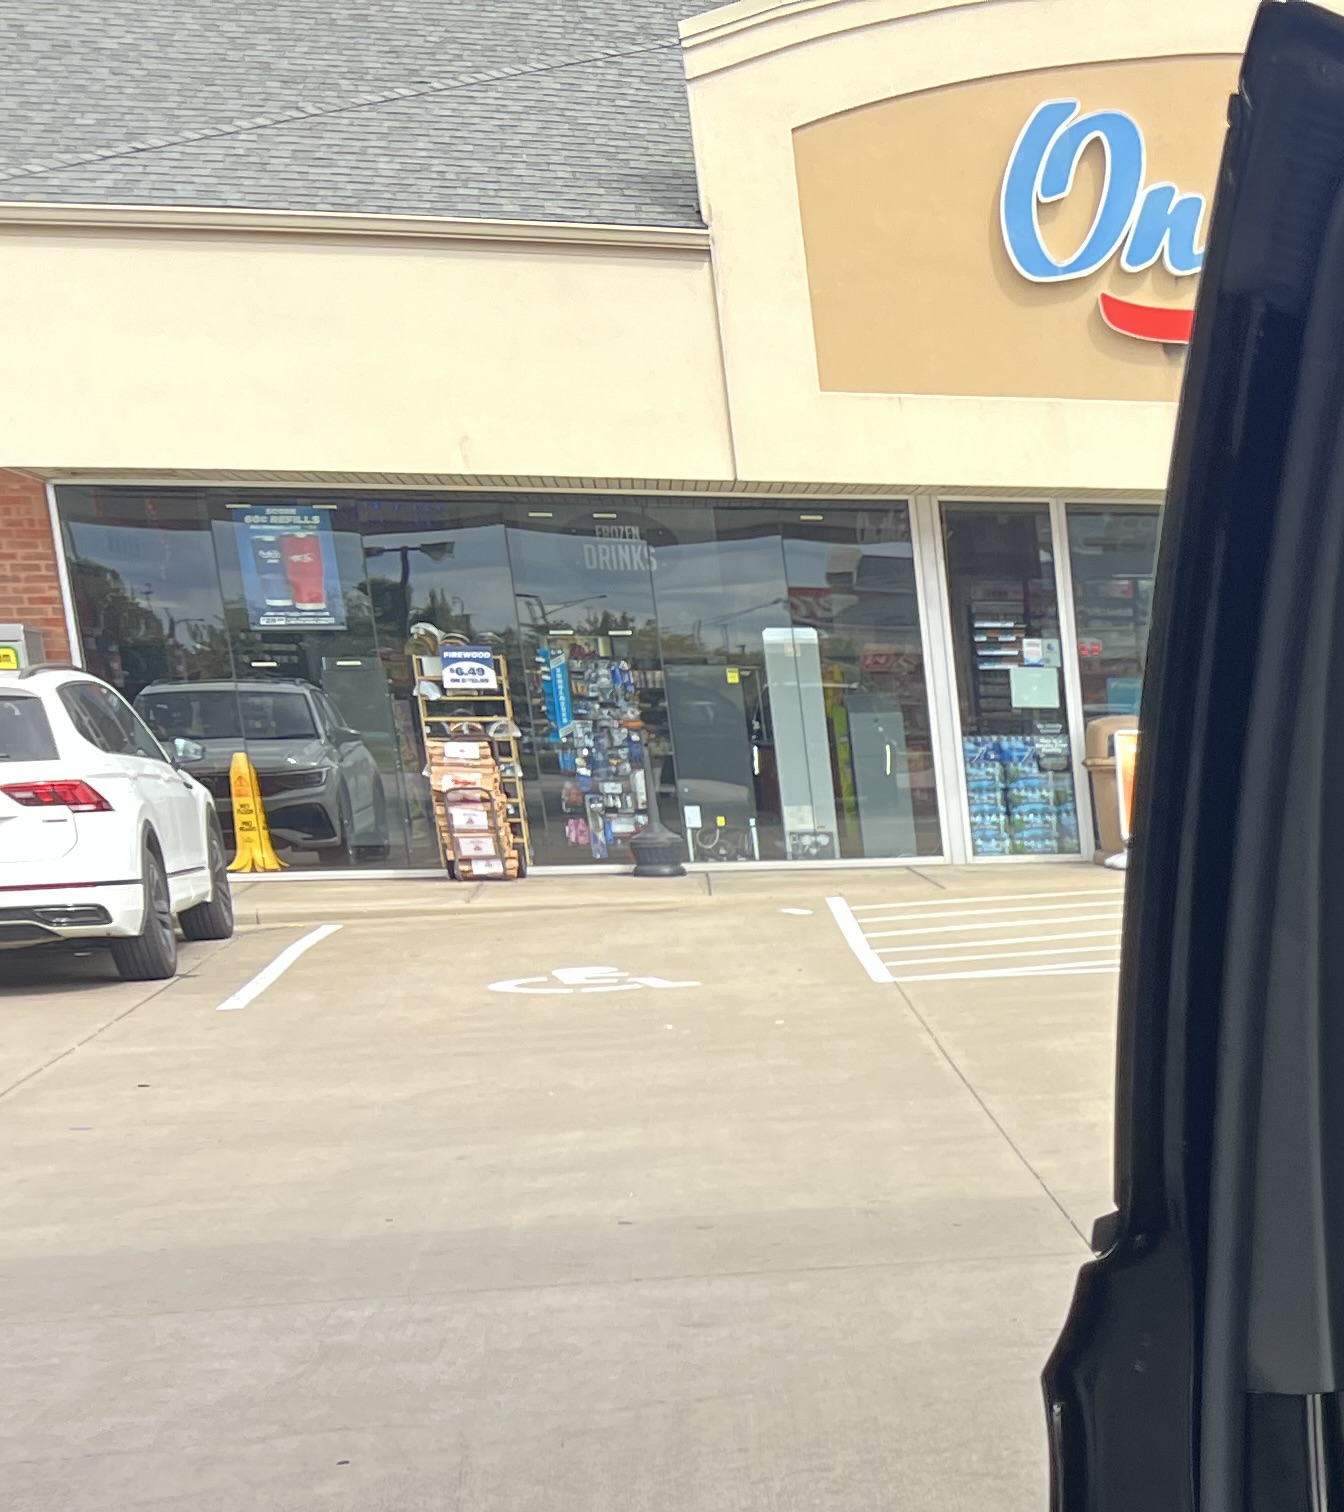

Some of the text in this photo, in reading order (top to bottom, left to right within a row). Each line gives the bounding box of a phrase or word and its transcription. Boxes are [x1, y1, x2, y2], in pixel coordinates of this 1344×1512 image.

[269, 515, 320, 524] REFILLS
[594, 524, 640, 541] FROZEN
[583, 543, 657, 572] DRINKS
[443, 651, 491, 659] FIREWOOD
[449, 667, 485, 677] $6.49
